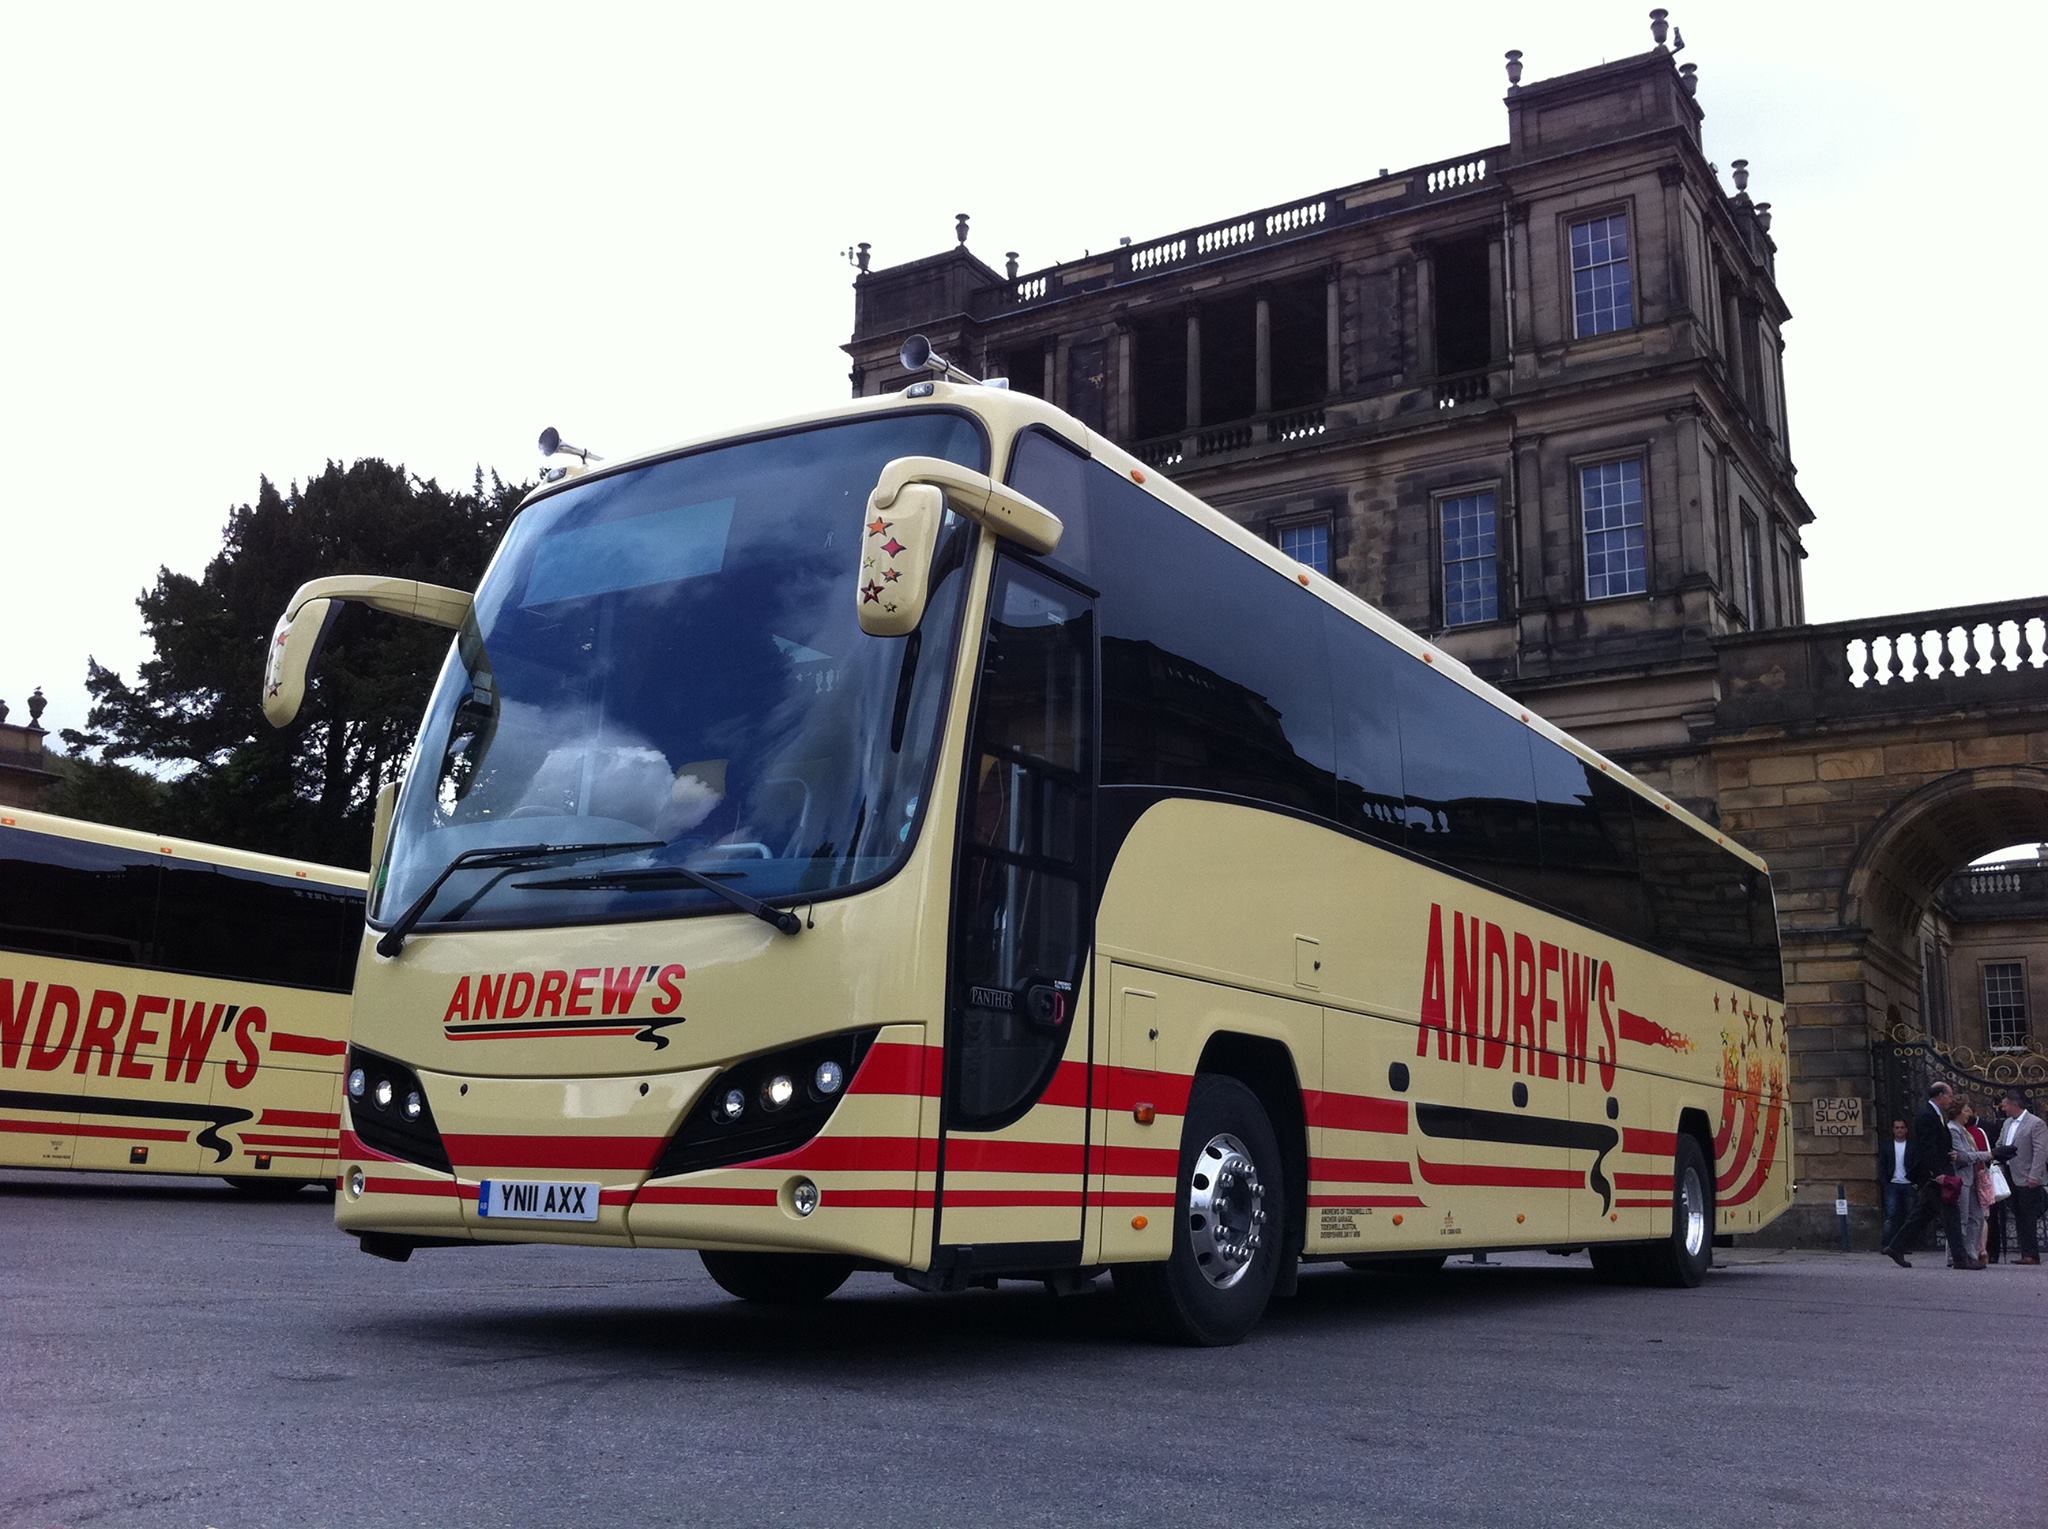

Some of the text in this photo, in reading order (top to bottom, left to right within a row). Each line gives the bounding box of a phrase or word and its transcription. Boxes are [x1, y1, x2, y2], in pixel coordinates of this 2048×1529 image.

[443, 963, 687, 1022] ANDREW'S
[972, 988, 1013, 1009] PANTHER
[1416, 902, 1617, 1093] ANDREW'S
[1817, 1099, 1858, 1110] DEAD
[1815, 1110, 1860, 1122] SLOW
[1820, 1125, 1857, 1135] HOOT
[502, 1184, 587, 1214] YN11 AXX
